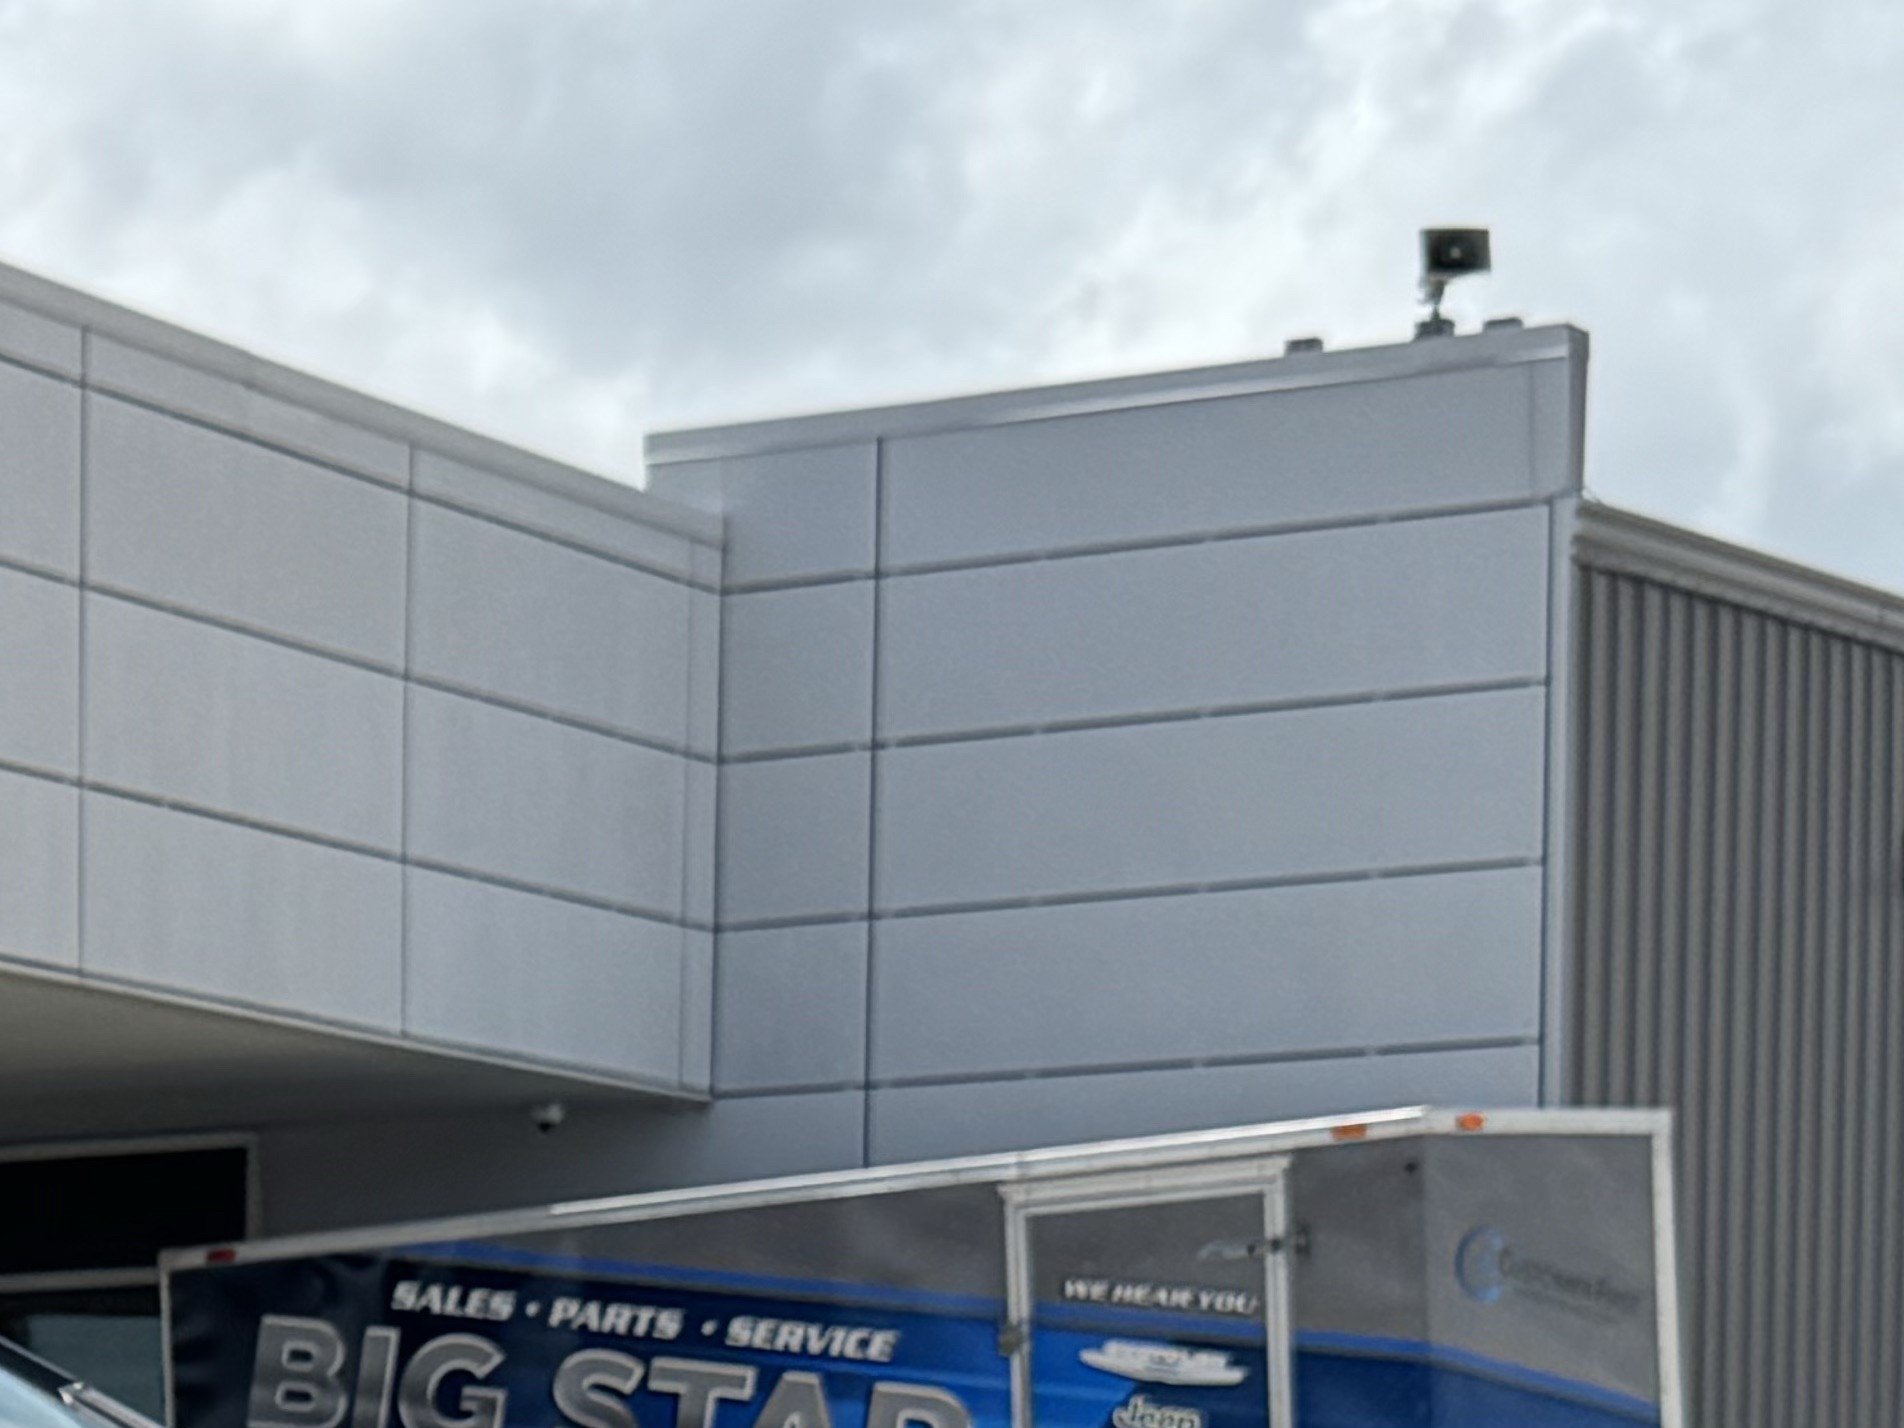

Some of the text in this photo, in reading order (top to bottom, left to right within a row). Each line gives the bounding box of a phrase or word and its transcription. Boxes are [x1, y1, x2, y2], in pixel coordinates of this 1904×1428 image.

[391, 1279, 901, 1364] SALES PARTS SERVICE
